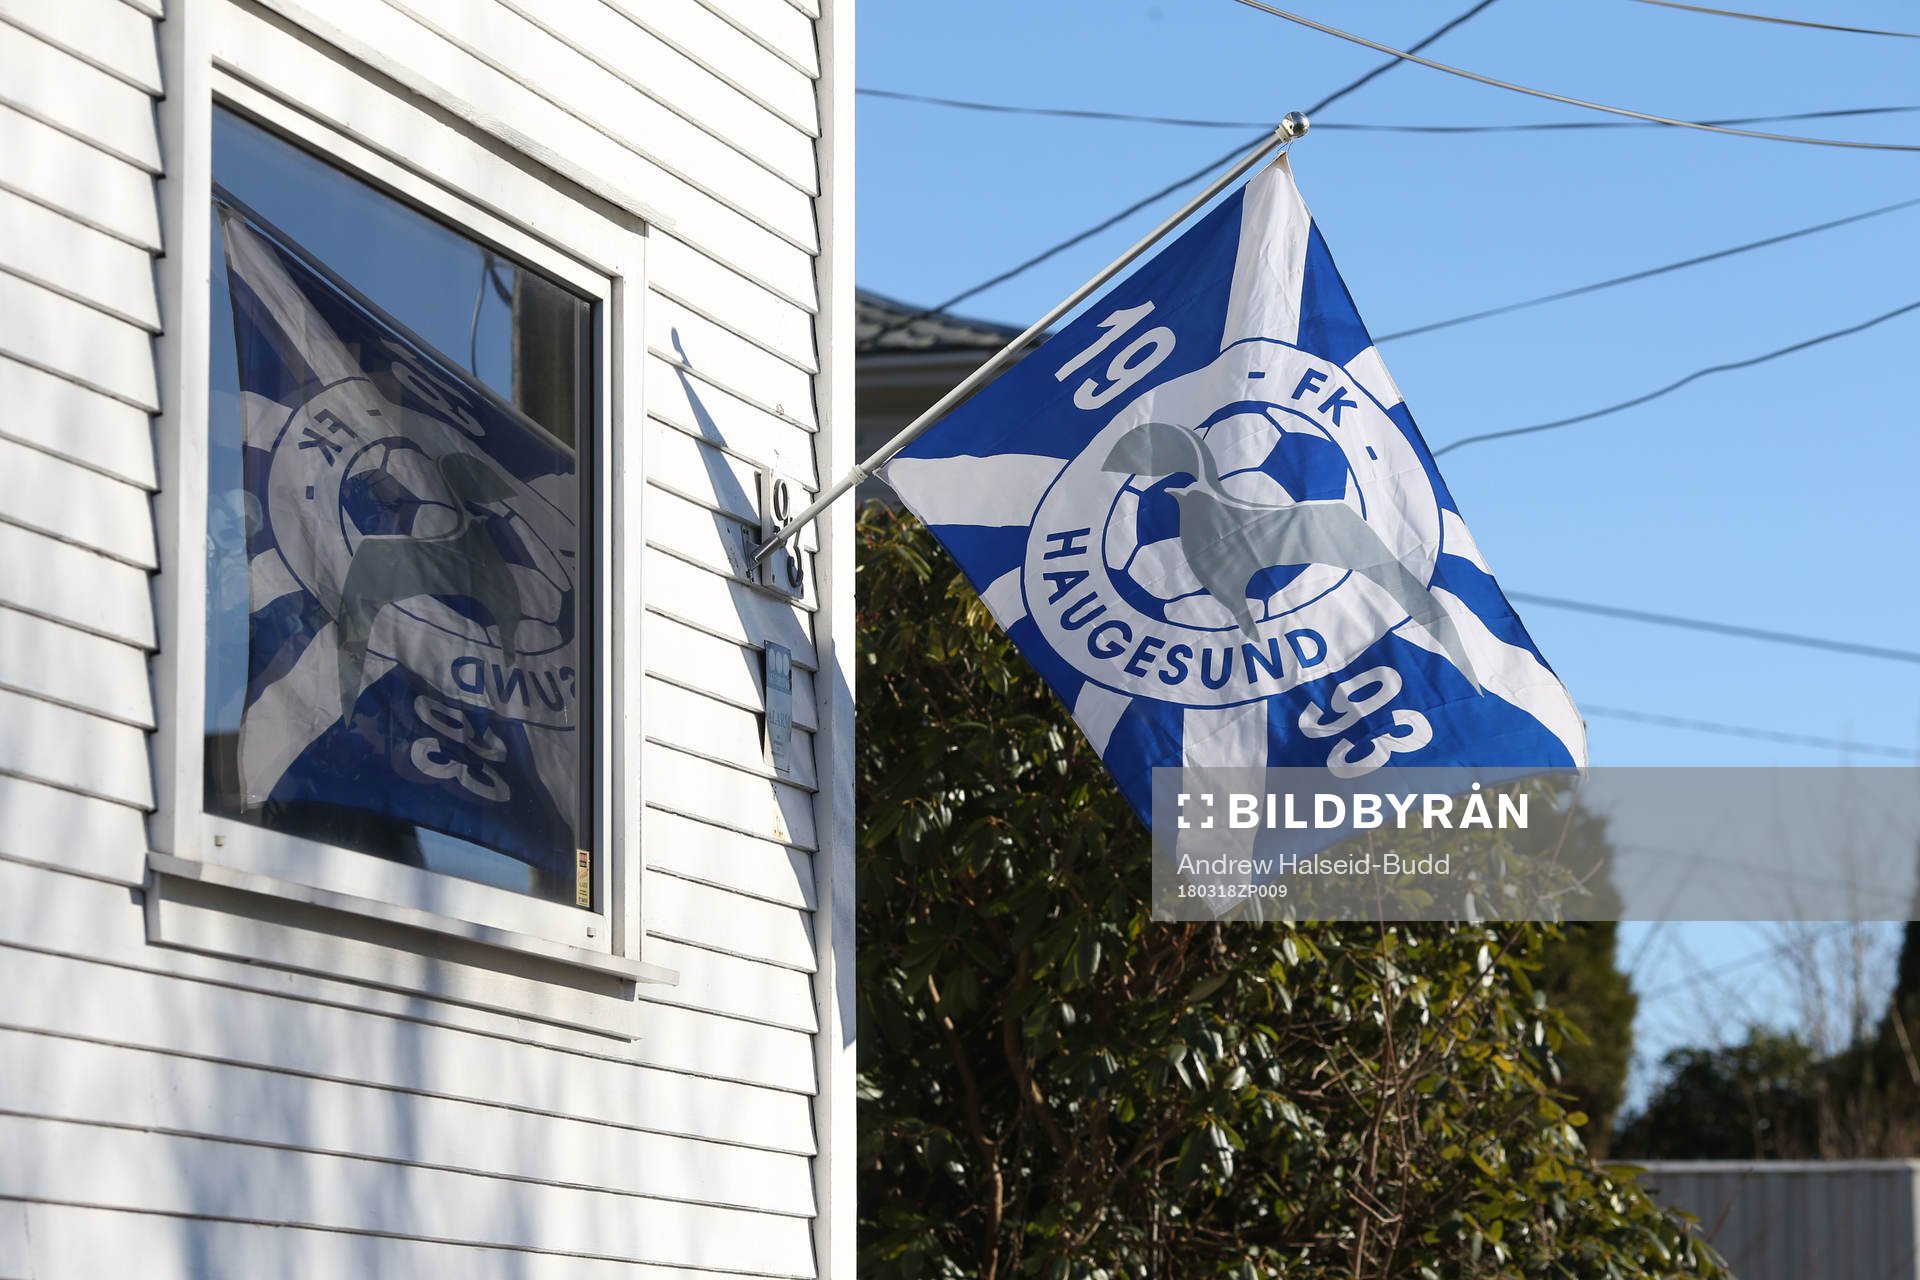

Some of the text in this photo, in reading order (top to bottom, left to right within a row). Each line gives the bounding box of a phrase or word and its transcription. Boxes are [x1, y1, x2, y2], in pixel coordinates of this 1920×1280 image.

[1054, 300, 1176, 410] 19
[1291, 368, 1358, 427] FK
[1043, 527, 1328, 690] HAUGESUND
[1298, 666, 1434, 779] 93
